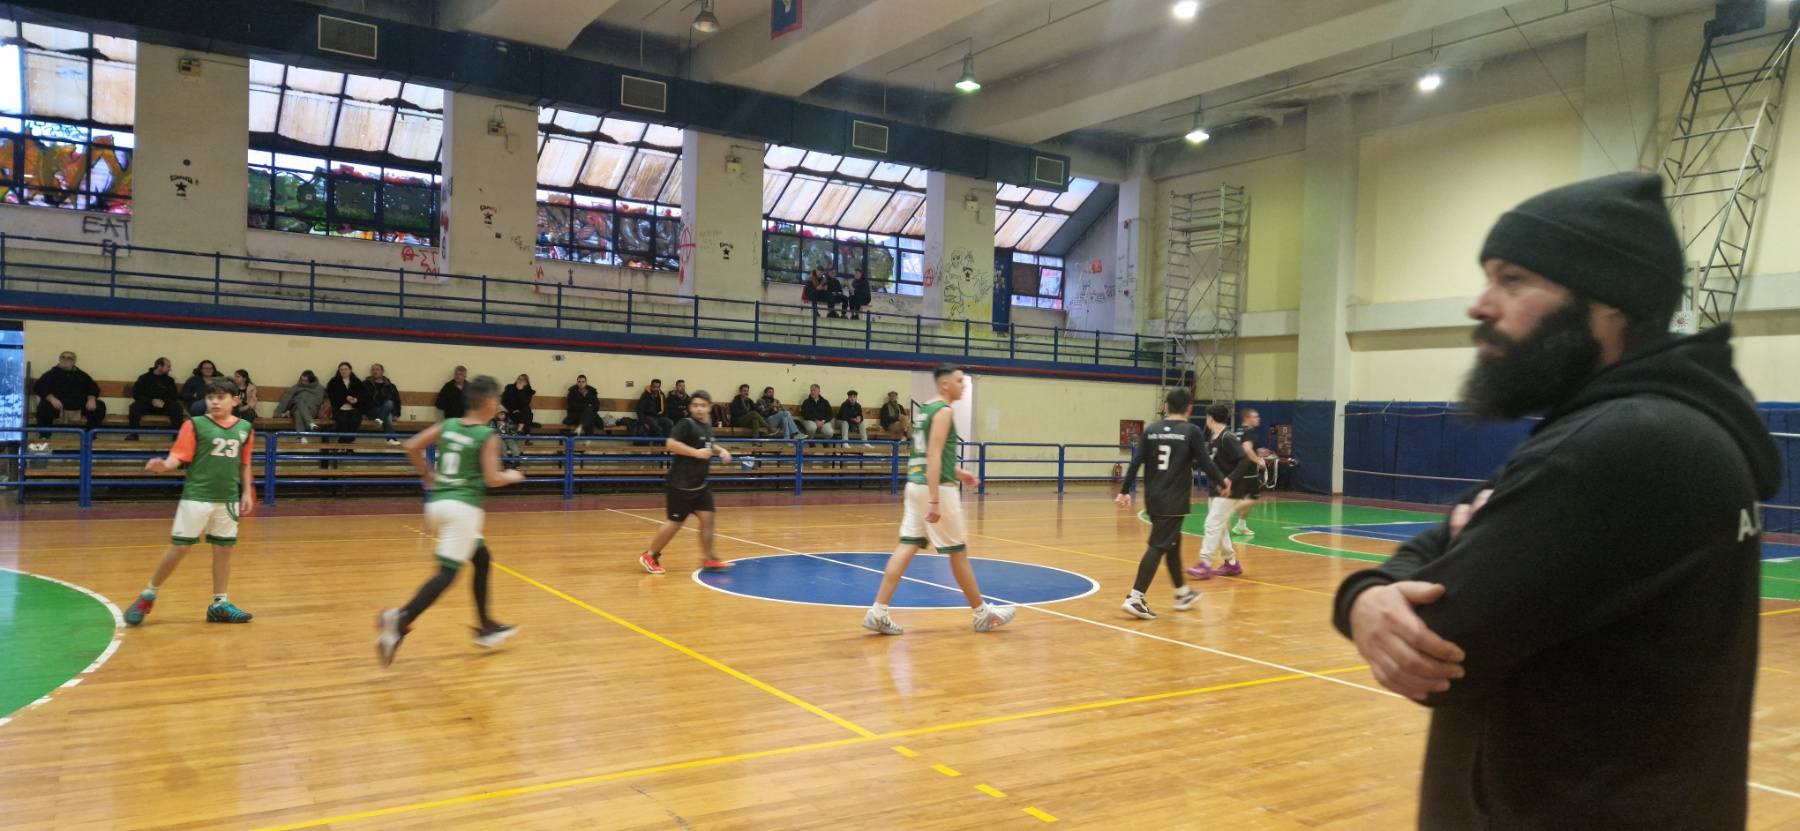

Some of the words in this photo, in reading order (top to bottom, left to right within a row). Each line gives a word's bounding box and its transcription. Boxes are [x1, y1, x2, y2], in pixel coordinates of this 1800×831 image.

[82, 215, 131, 241] EAT
[211, 437, 240, 457] 23
[1158, 444, 1172, 470] 3
